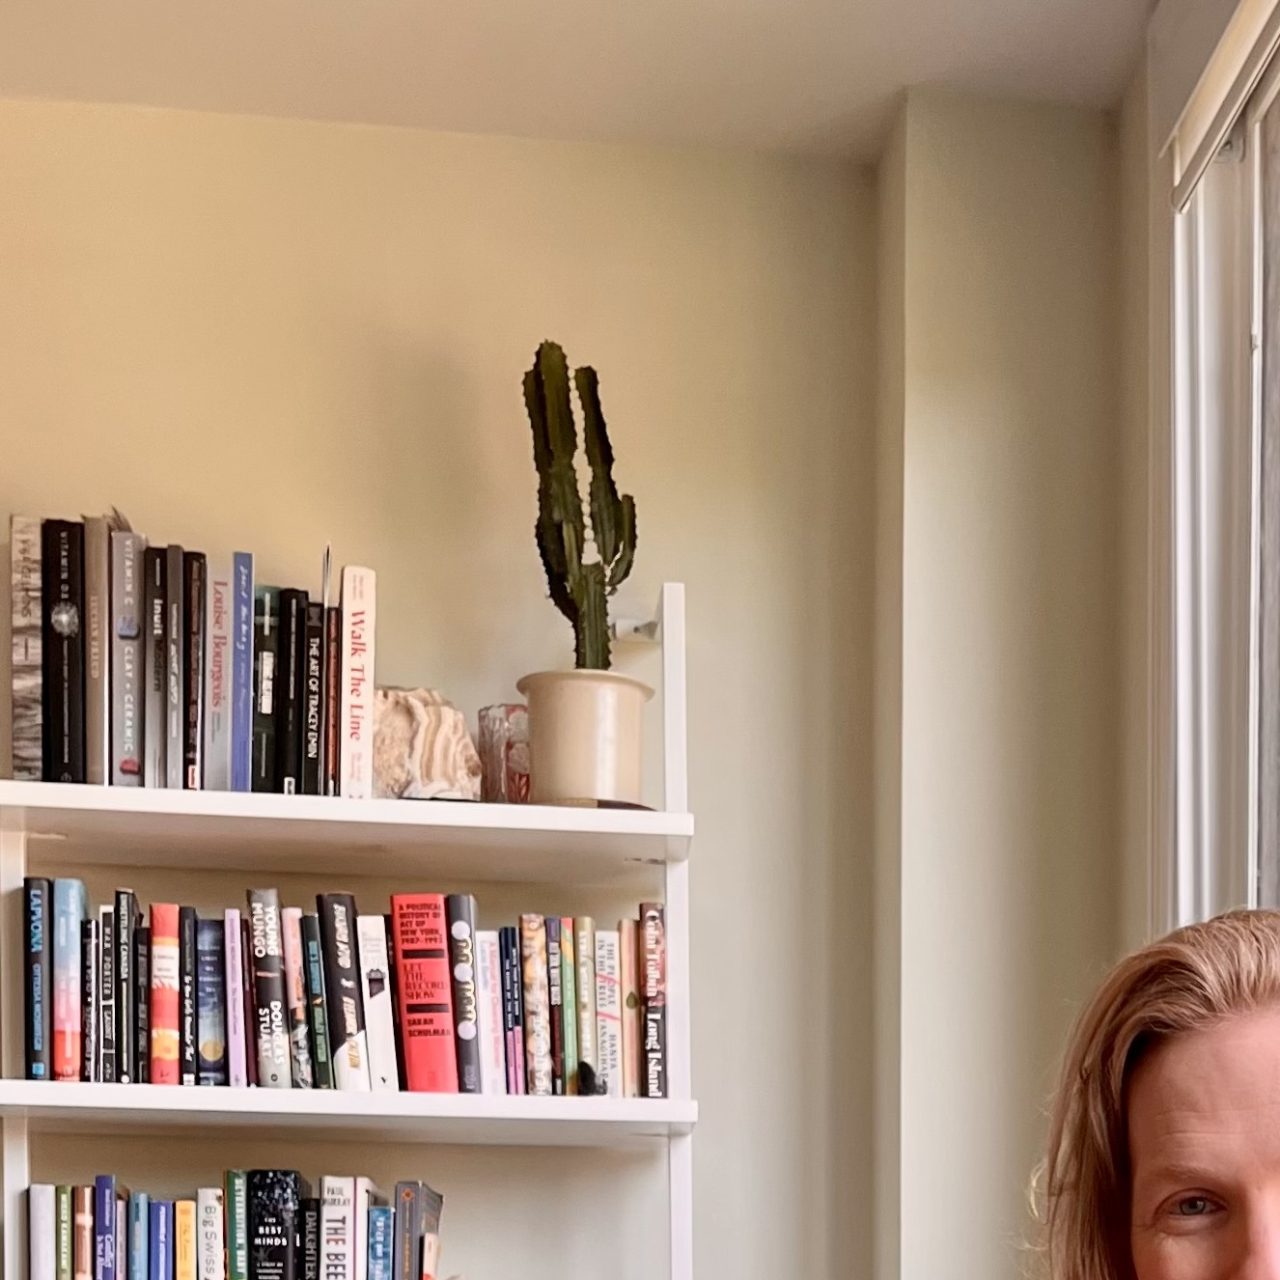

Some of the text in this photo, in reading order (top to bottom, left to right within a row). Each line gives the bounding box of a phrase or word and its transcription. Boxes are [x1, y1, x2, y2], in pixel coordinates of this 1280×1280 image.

[124, 539, 134, 591] VITAMIN
[210, 580, 228, 706] Louise Bourgeois
[350, 610, 367, 657] Walk
[124, 646, 133, 678] CLAY
[350, 664, 366, 697] The
[124, 694, 134, 752] CERAMIC
[307, 637, 320, 758] THE ART OF TRACEY EMIN
[349, 703, 365, 741] Line
[31, 889, 43, 953] LAPVONA
[252, 903, 266, 958] MUNGO
[264, 904, 279, 956] YOUNG
[400, 920, 427, 929] ACT UP
[400, 929, 419, 937] NEW
[598, 940, 605, 950] IN
[120, 945, 128, 979] CANADA
[598, 953, 606, 972] THE
[607, 965, 615, 1006] PEOPLE
[258, 1008, 272, 1058] STUART
[269, 1000, 285, 1064] DOUGLAS
[407, 1018, 434, 1027] SARAH
[598, 1019, 608, 1080] YANAGIHAR
[646, 1013, 663, 1097] Long Island
[202, 1205, 217, 1274] Big Swiss
[254, 1237, 288, 1246] MINDS
[305, 1211, 317, 1280] DAUGHTER
[326, 1215, 346, 1280] THE BEE
